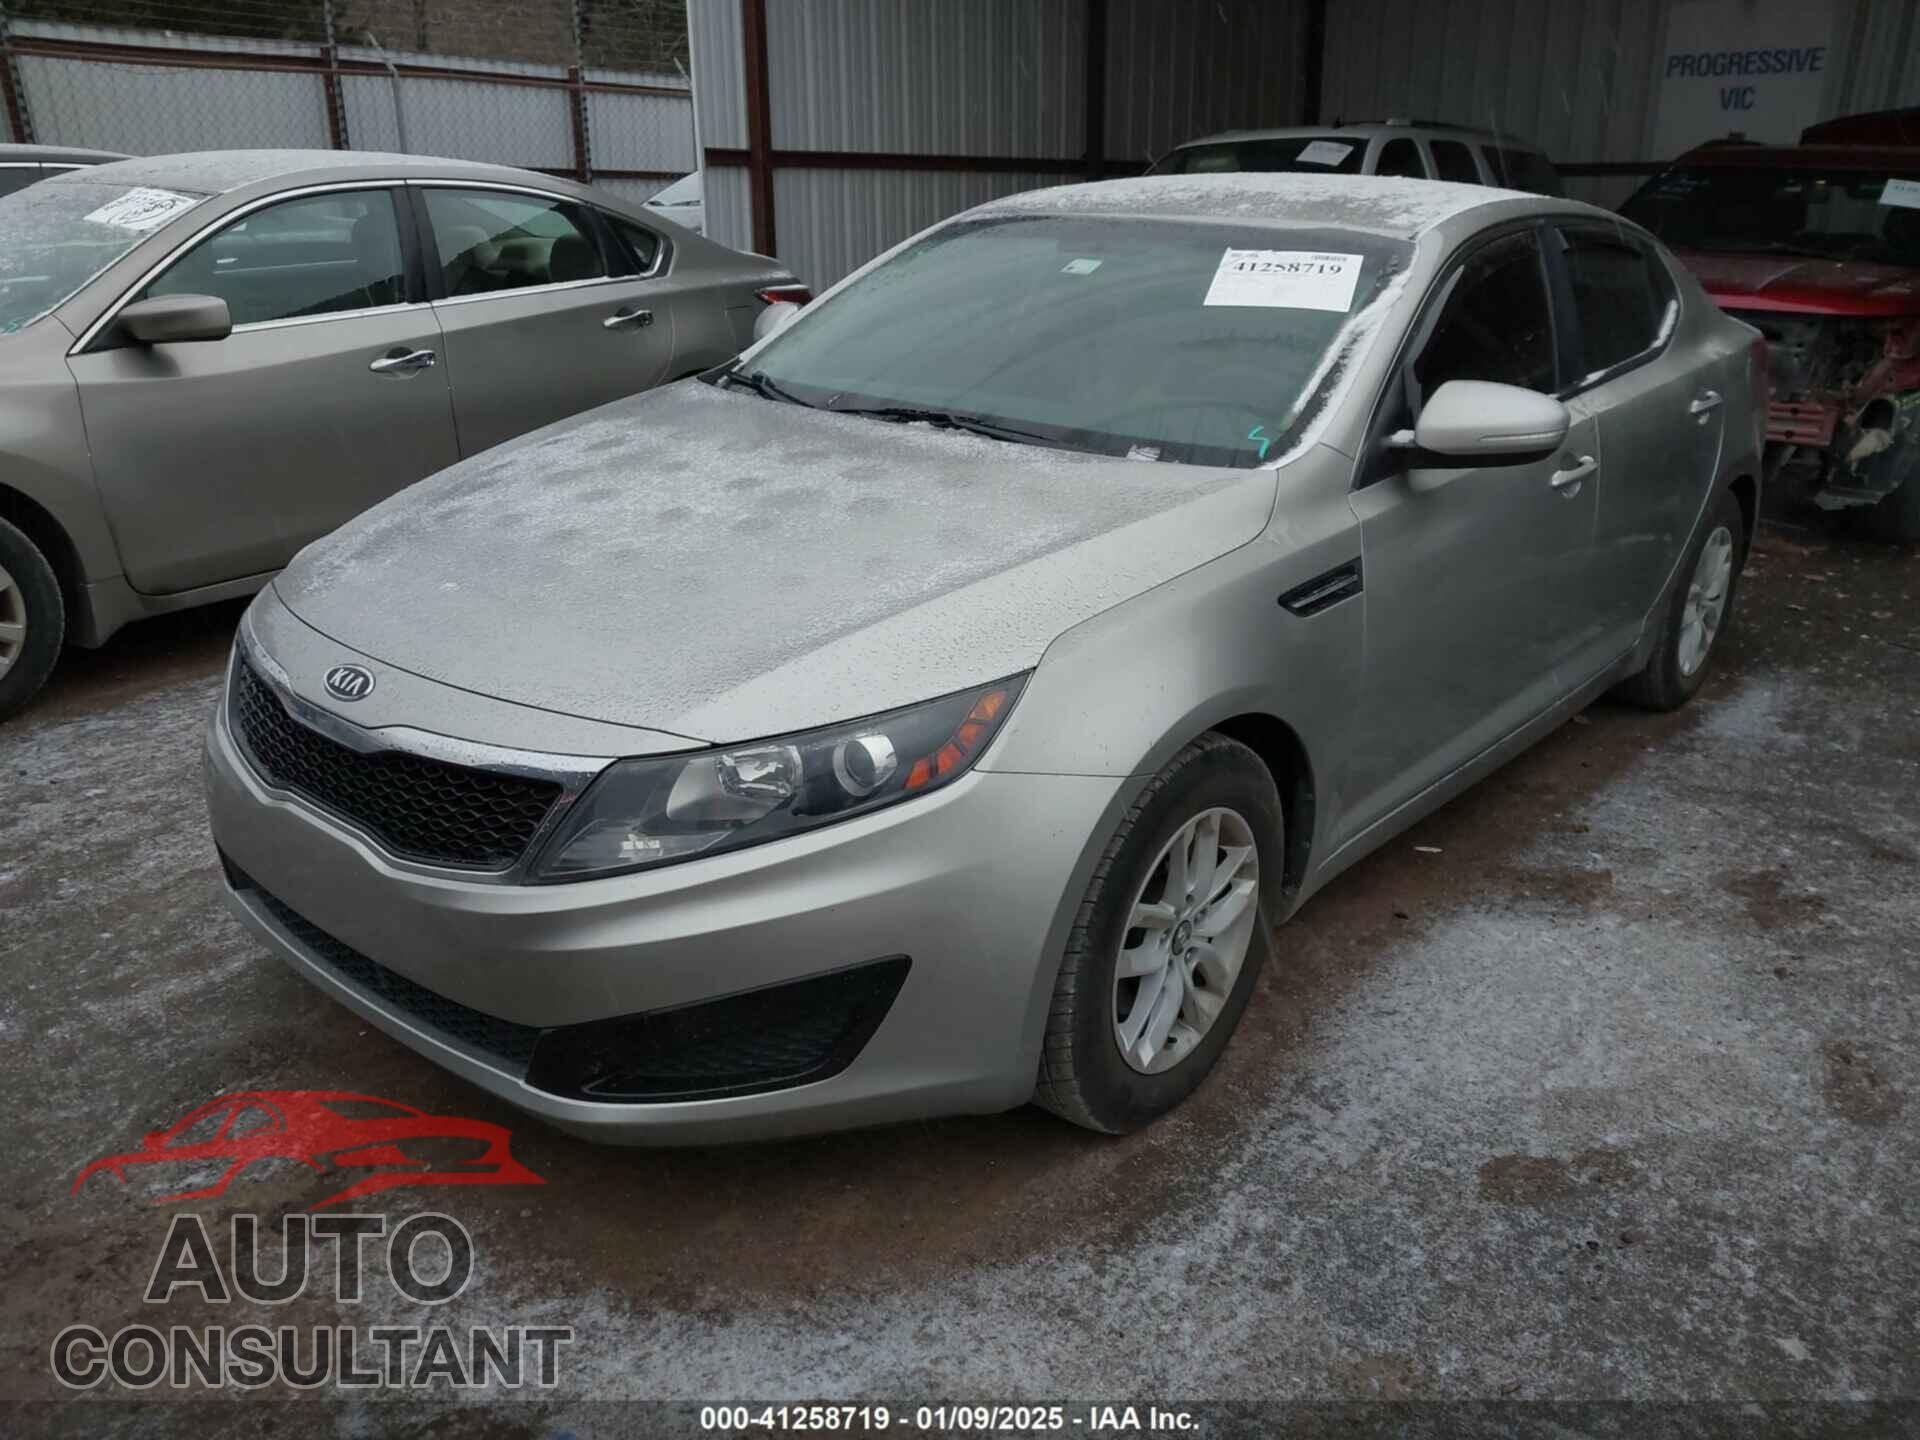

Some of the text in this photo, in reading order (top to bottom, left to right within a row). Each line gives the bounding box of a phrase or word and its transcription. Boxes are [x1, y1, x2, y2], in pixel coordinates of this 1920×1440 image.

[1666, 47, 1825, 78] PROGRESSIVE
[1720, 86, 1755, 110] VIC
[328, 667, 365, 696] KIA
